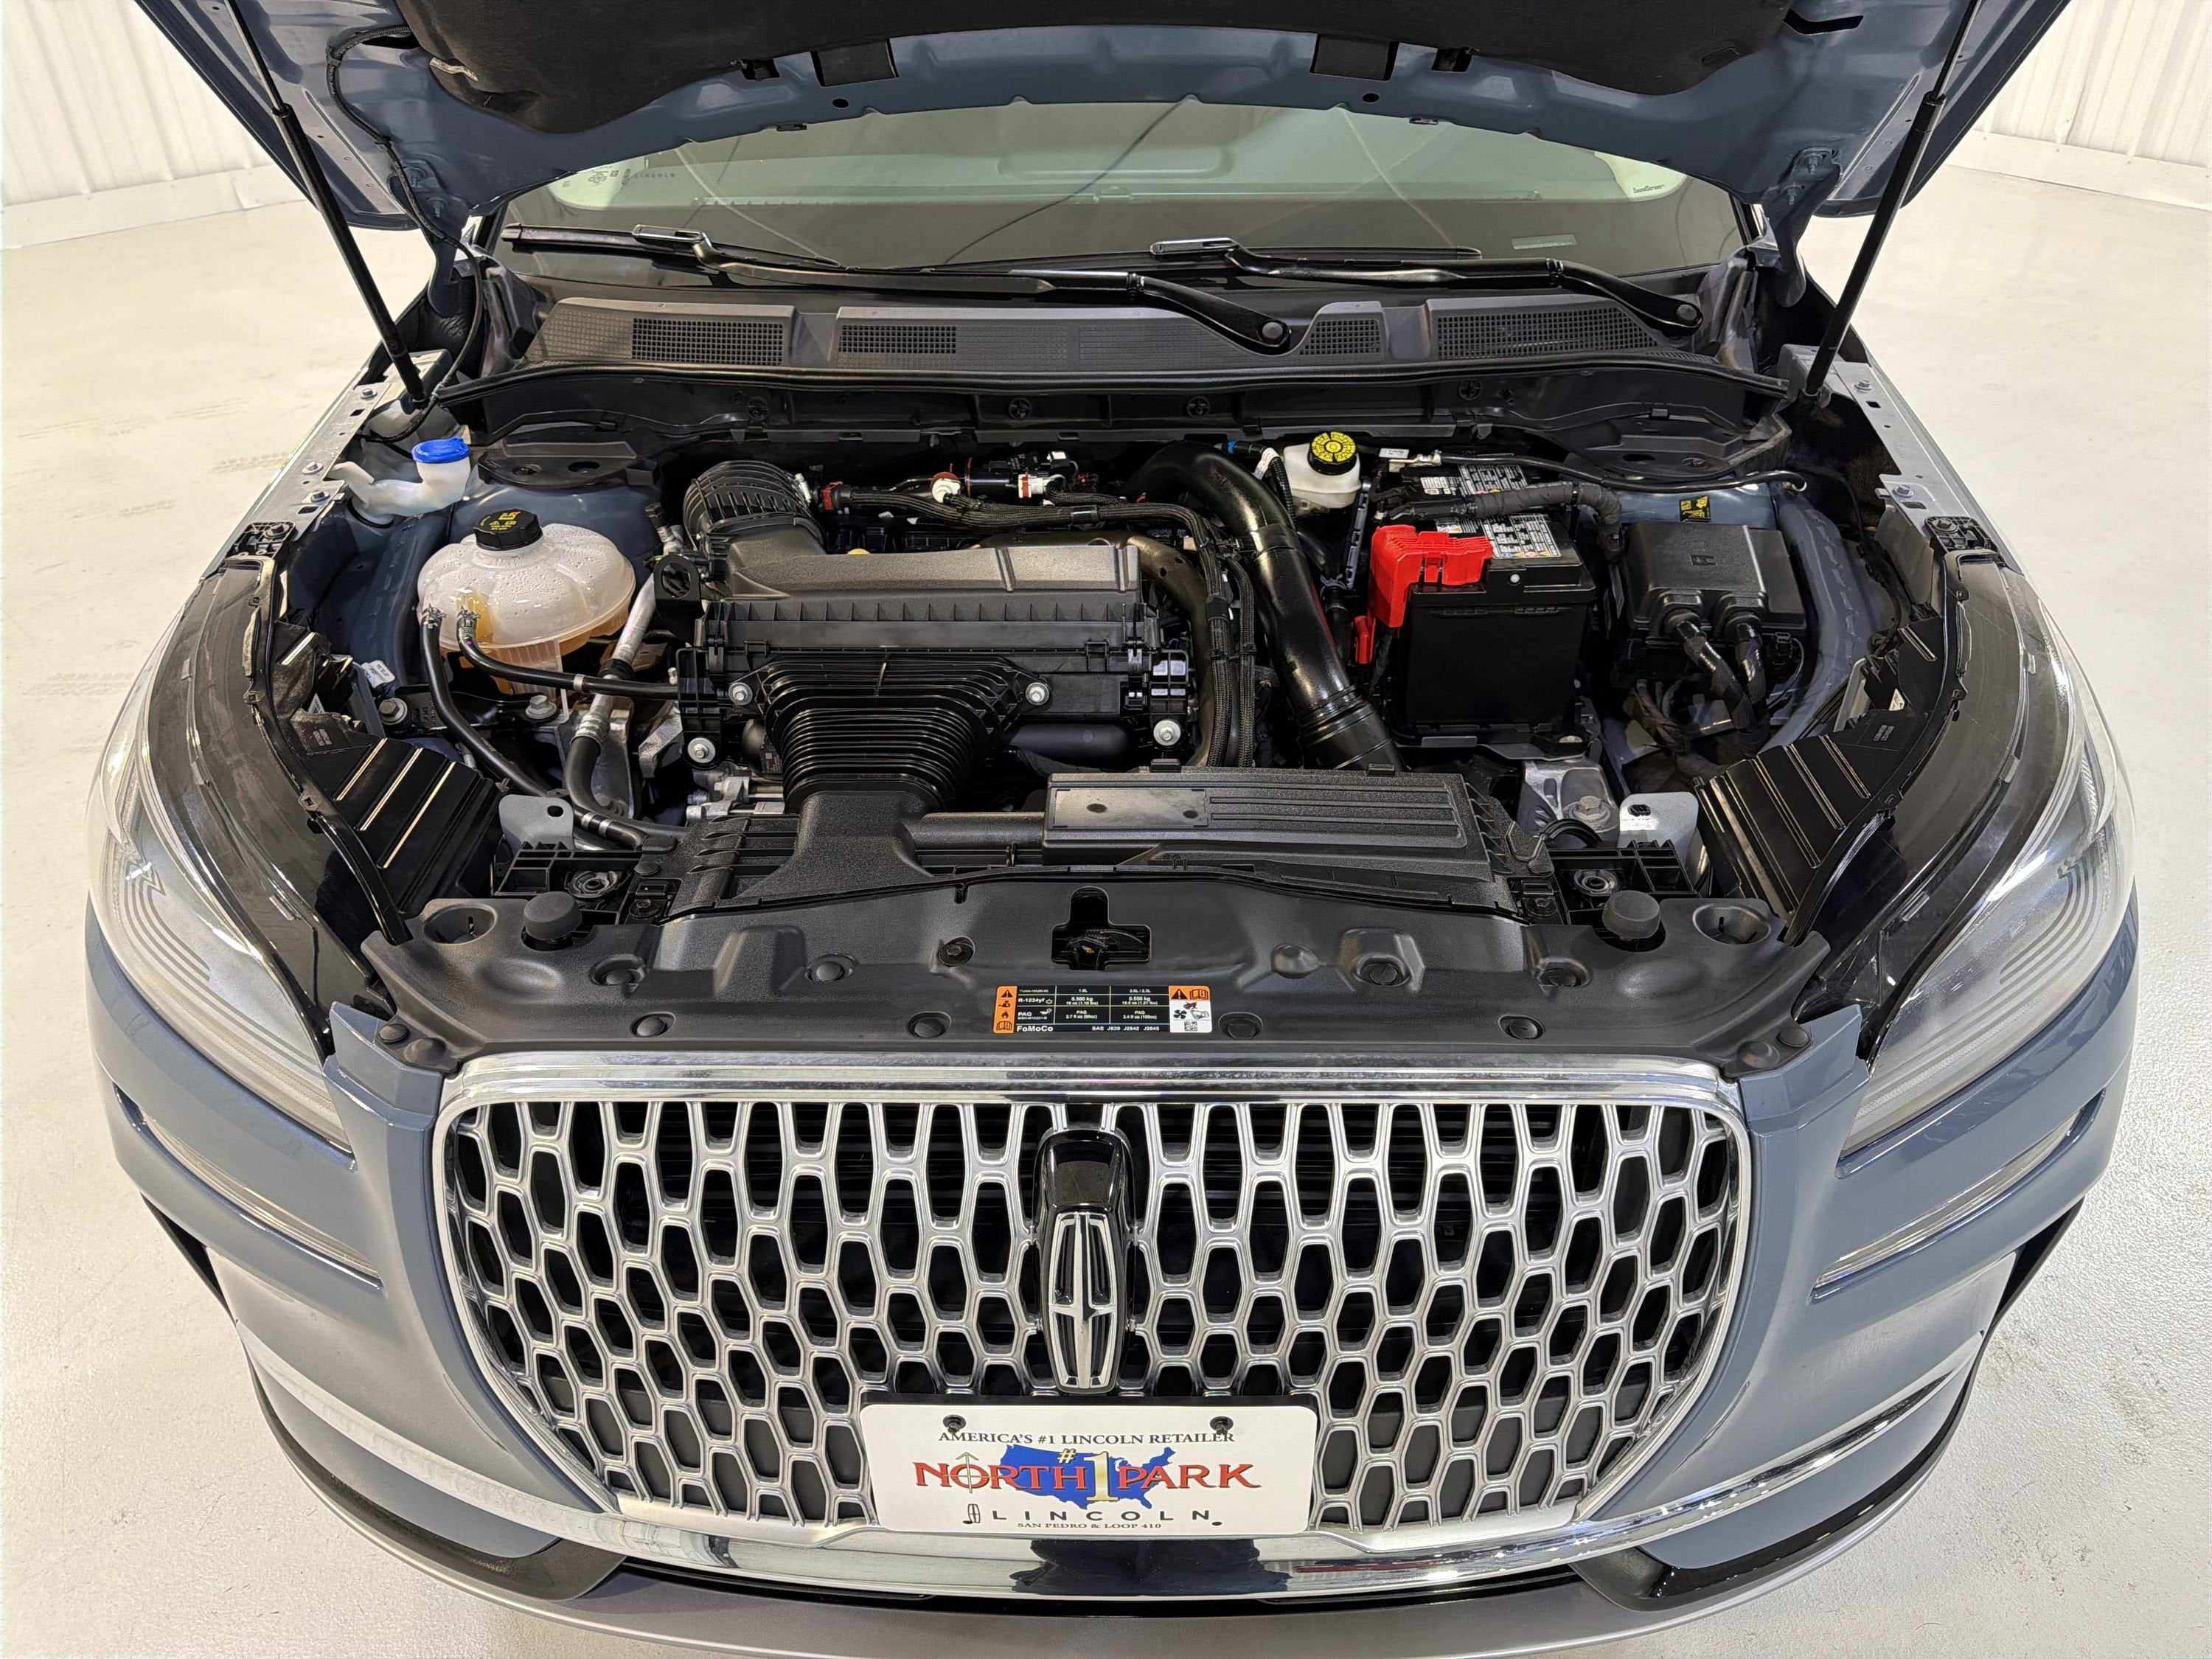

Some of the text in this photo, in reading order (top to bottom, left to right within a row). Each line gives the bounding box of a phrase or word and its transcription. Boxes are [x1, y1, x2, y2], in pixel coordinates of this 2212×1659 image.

[939, 1432, 1235, 1444] AMERICA'S #1 LINCOLN RETAILER
[912, 1462, 1262, 1490] NORTH PARK
[992, 1510, 1209, 1520] LINCOLN
